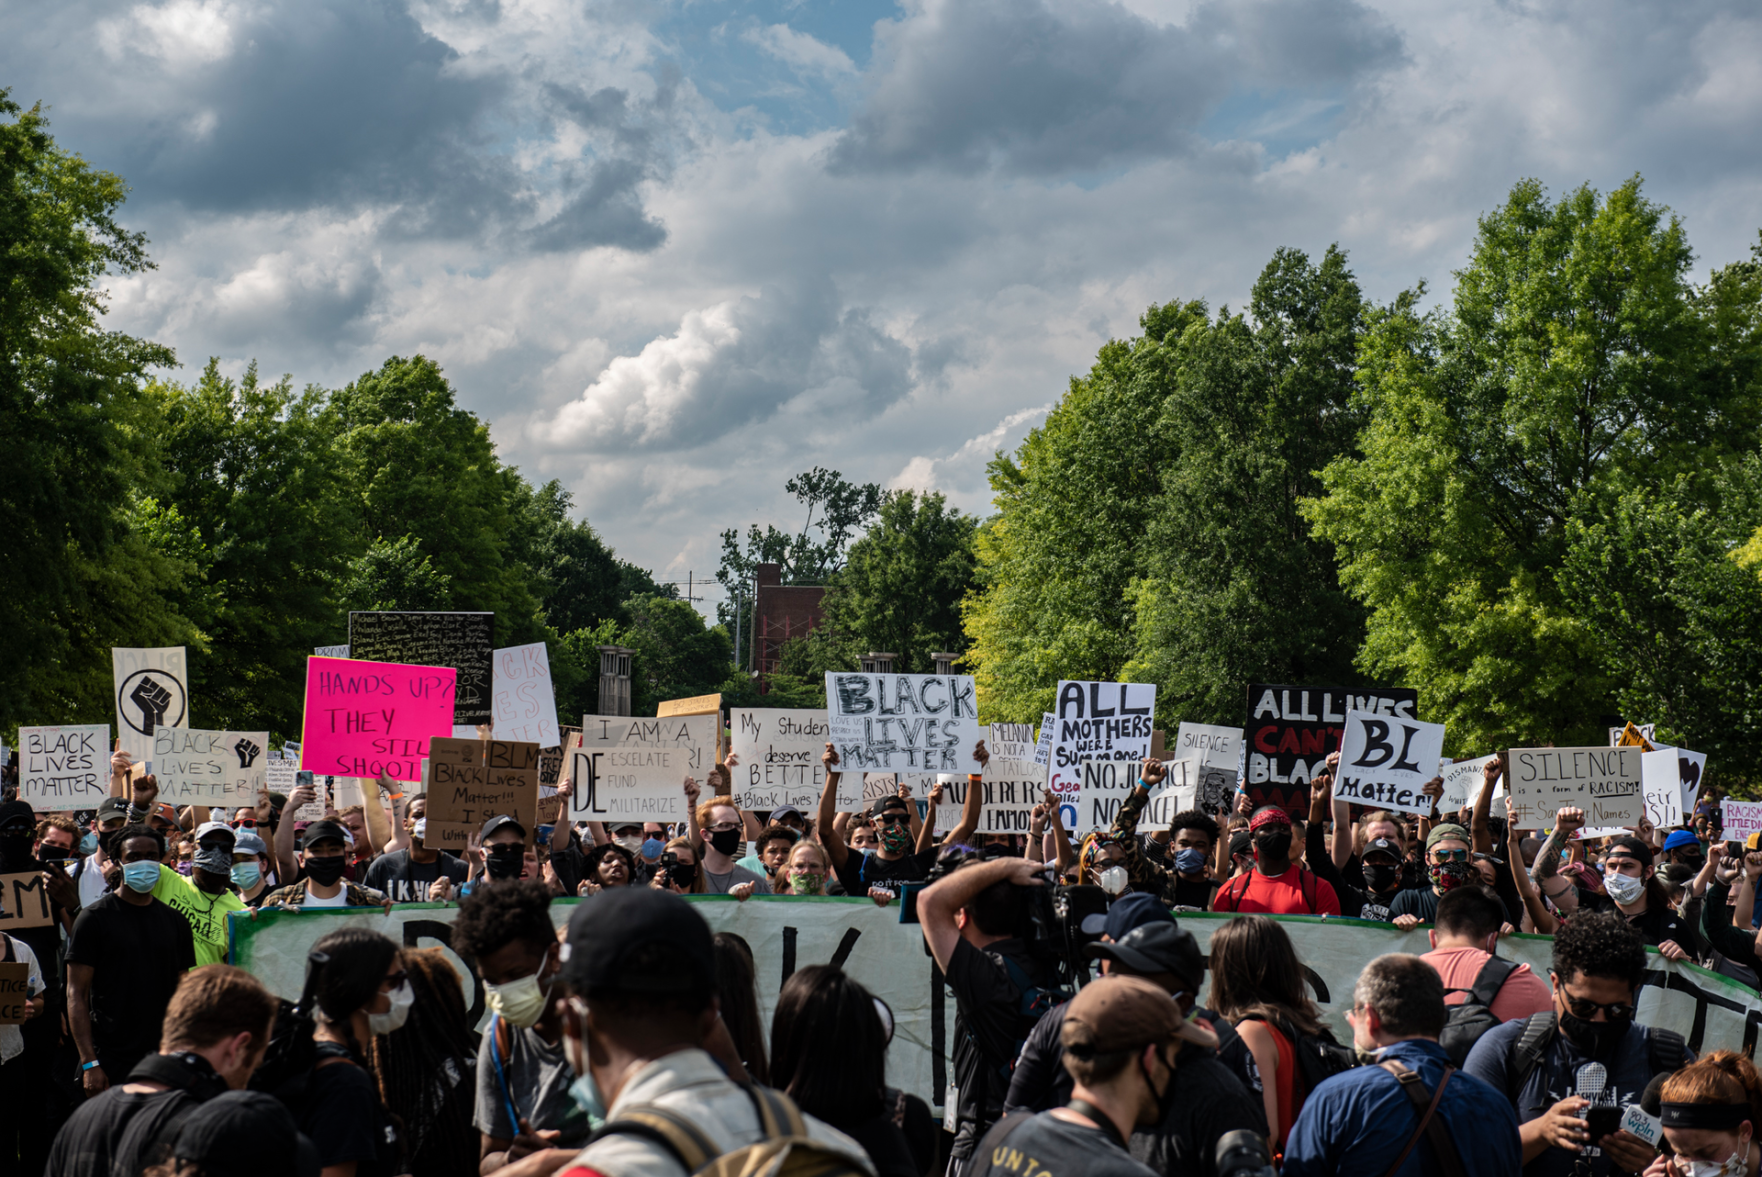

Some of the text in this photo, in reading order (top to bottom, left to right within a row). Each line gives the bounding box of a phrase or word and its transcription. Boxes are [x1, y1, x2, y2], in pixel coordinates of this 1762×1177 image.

[320, 671, 455, 708] HANDS UP?
[834, 674, 978, 719] BLACK
[1059, 682, 1150, 719] ALL
[1253, 689, 1417, 722] ALL LIVES
[323, 708, 395, 735] THEY
[598, 719, 611, 740] I
[626, 721, 660, 742] AM
[674, 722, 690, 741] A
[741, 712, 762, 743] My
[778, 716, 830, 736] Studen
[830, 716, 863, 726] LOVE US
[864, 716, 960, 748] LIVES
[991, 723, 1034, 743] MELANIN
[1061, 715, 1152, 742] MOTHERS
[29, 732, 96, 754] BLACK
[155, 728, 229, 756] BLACK
[372, 738, 429, 757] STIL
[992, 743, 1026, 756] IS NOT A
[1076, 739, 1113, 753] WERE
[1183, 733, 1229, 753] SILENCE
[1254, 725, 1344, 755] CAN'T
[1350, 719, 1422, 774] BL
[29, 754, 93, 772] LIVES
[489, 741, 541, 770] BLM
[764, 744, 811, 763] deserve
[840, 743, 958, 770] MATTER
[337, 754, 421, 779] SHOOT
[1085, 760, 1191, 790] NO JUICE
[1520, 750, 1629, 782] SILENCE
[26, 773, 105, 797] MATTER
[573, 752, 607, 813] DE
[608, 775, 637, 788] FUND
[941, 781, 1046, 805] MUDERERS
[1336, 776, 1431, 808] Matter!
[1552, 785, 1571, 793] form
[1577, 783, 1585, 792] of
[1589, 780, 1640, 794] RACISM!
[452, 787, 514, 804] Matter!!!
[610, 797, 677, 813] MILITARIZE
[733, 791, 779, 809] #Black
[785, 791, 812, 806] Lives
[462, 809, 475, 824] I
[1628, 1118, 1655, 1138] wpln
[1630, 1110, 1649, 1126] 90.3
